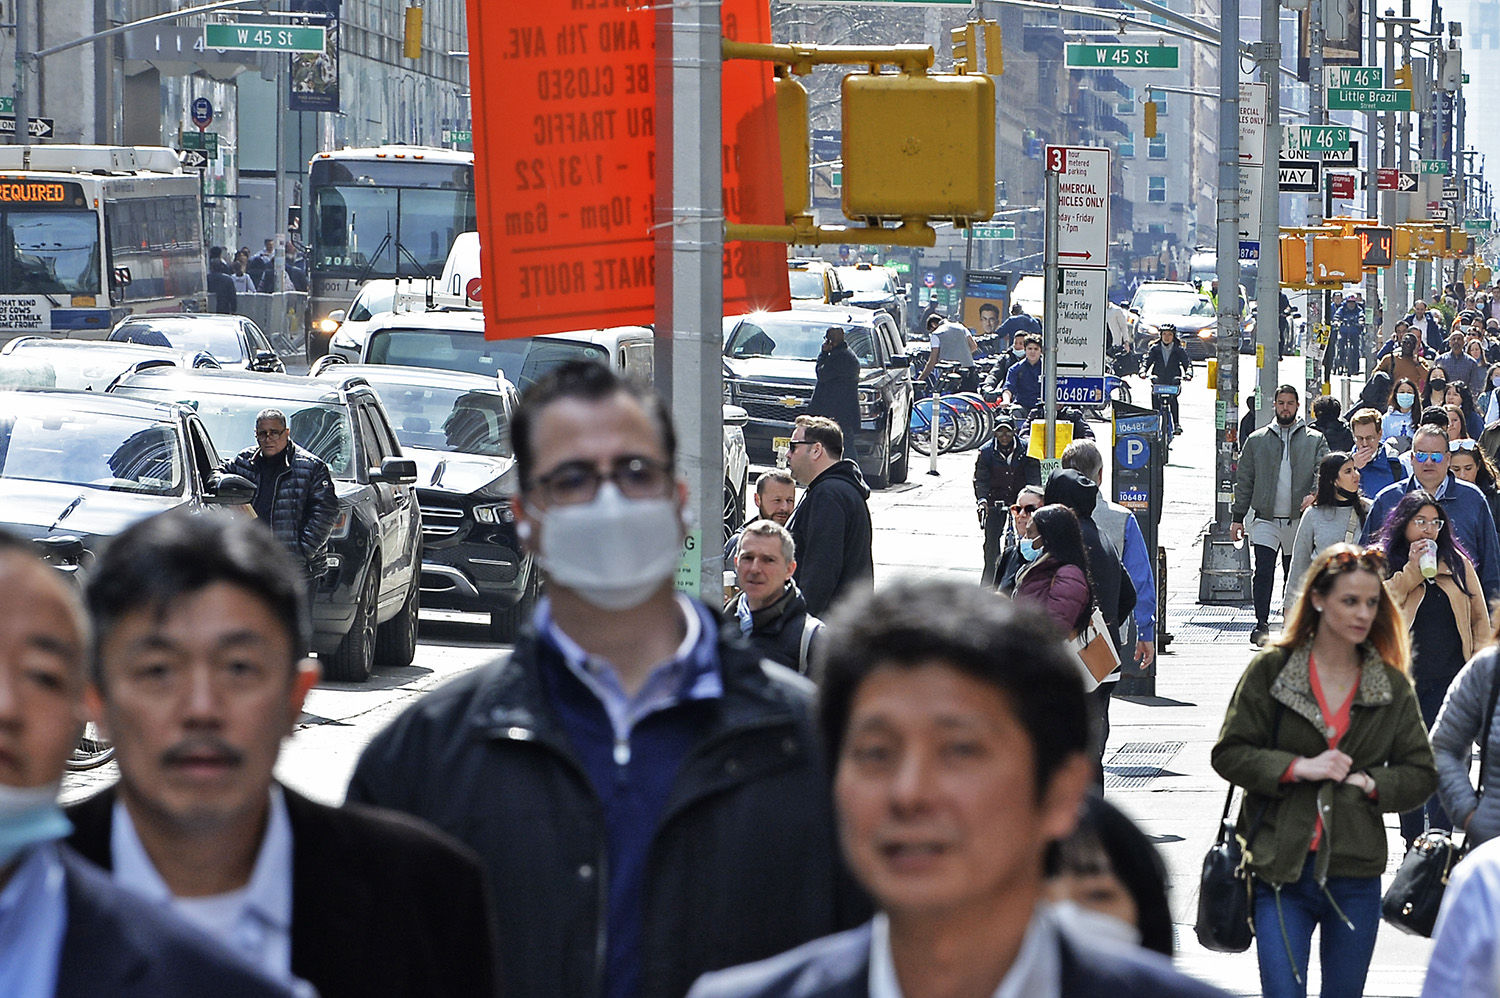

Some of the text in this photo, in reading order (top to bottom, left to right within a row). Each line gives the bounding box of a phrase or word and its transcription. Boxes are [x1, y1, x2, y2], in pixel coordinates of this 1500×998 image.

[237, 29, 293, 46] W 45 St
[1096, 49, 1149, 64] W 45 St
[1341, 70, 1380, 86] W 46 St
[1339, 90, 1397, 103] Little Brazil
[1240, 107, 1259, 116] ERCIAL
[1301, 129, 1346, 147] W 46 St
[1068, 150, 1080, 158] hour
[1288, 150, 1347, 160] ONE WAY
[1051, 149, 1062, 172] 3
[1068, 159, 1090, 167] metered
[1068, 168, 1087, 177] parking
[1421, 162, 1428, 172] W
[1430, 162, 1439, 173] 45
[1059, 183, 1097, 194] MMERCIAL
[1058, 196, 1105, 208] HICLES ONLY
[1058, 213, 1071, 223] day
[1076, 213, 1094, 224] Friday
[1066, 224, 1078, 233] 7pm
[1380, 237, 1390, 259] 4
[1065, 270, 1078, 278] hour
[1065, 279, 1088, 287] metered
[1065, 288, 1085, 296] parking
[9, 306, 31, 314] COWS
[1074, 300, 1092, 311] Friday
[1064, 311, 1088, 321] Midnight
[1064, 336, 1088, 346] Midnight
[1056, 387, 1088, 401] 06487
[1127, 440, 1144, 464] P
[1041, 461, 1059, 470] KING
